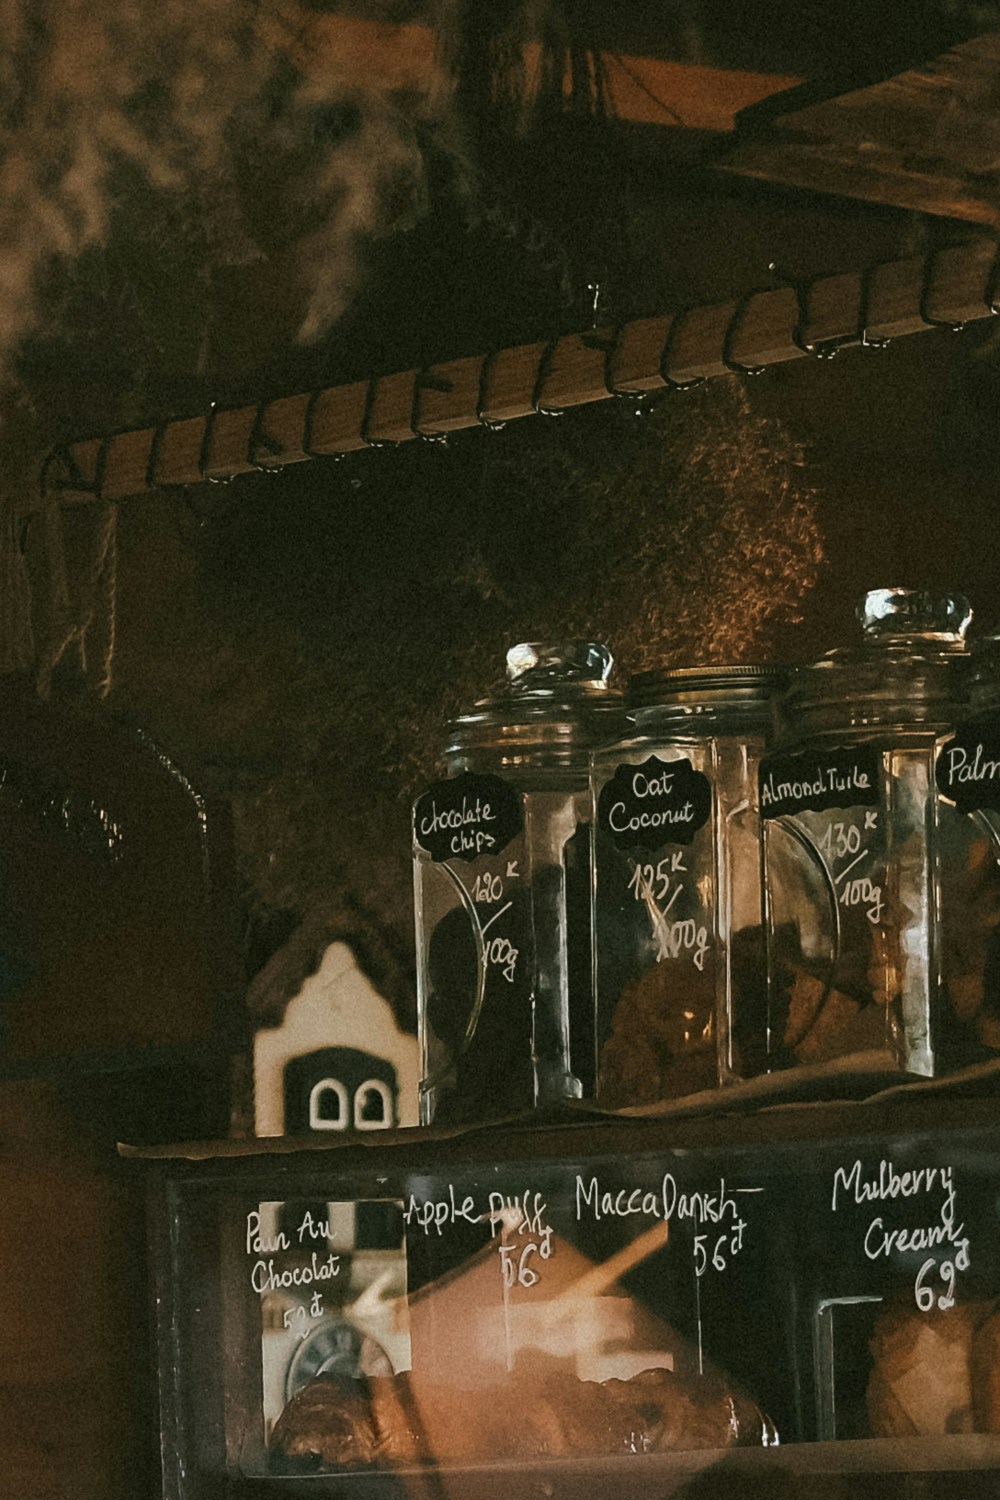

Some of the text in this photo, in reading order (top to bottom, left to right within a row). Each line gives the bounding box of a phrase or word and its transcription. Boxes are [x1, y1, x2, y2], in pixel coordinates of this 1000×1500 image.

[632, 772, 673, 801] Oat
[608, 803, 695, 832] Coconut
[402, 1184, 482, 1236] Apple
[832, 1160, 957, 1224] Mulberry
[297, 1211, 337, 1243] Au
[251, 1252, 340, 1293] Chocolat
